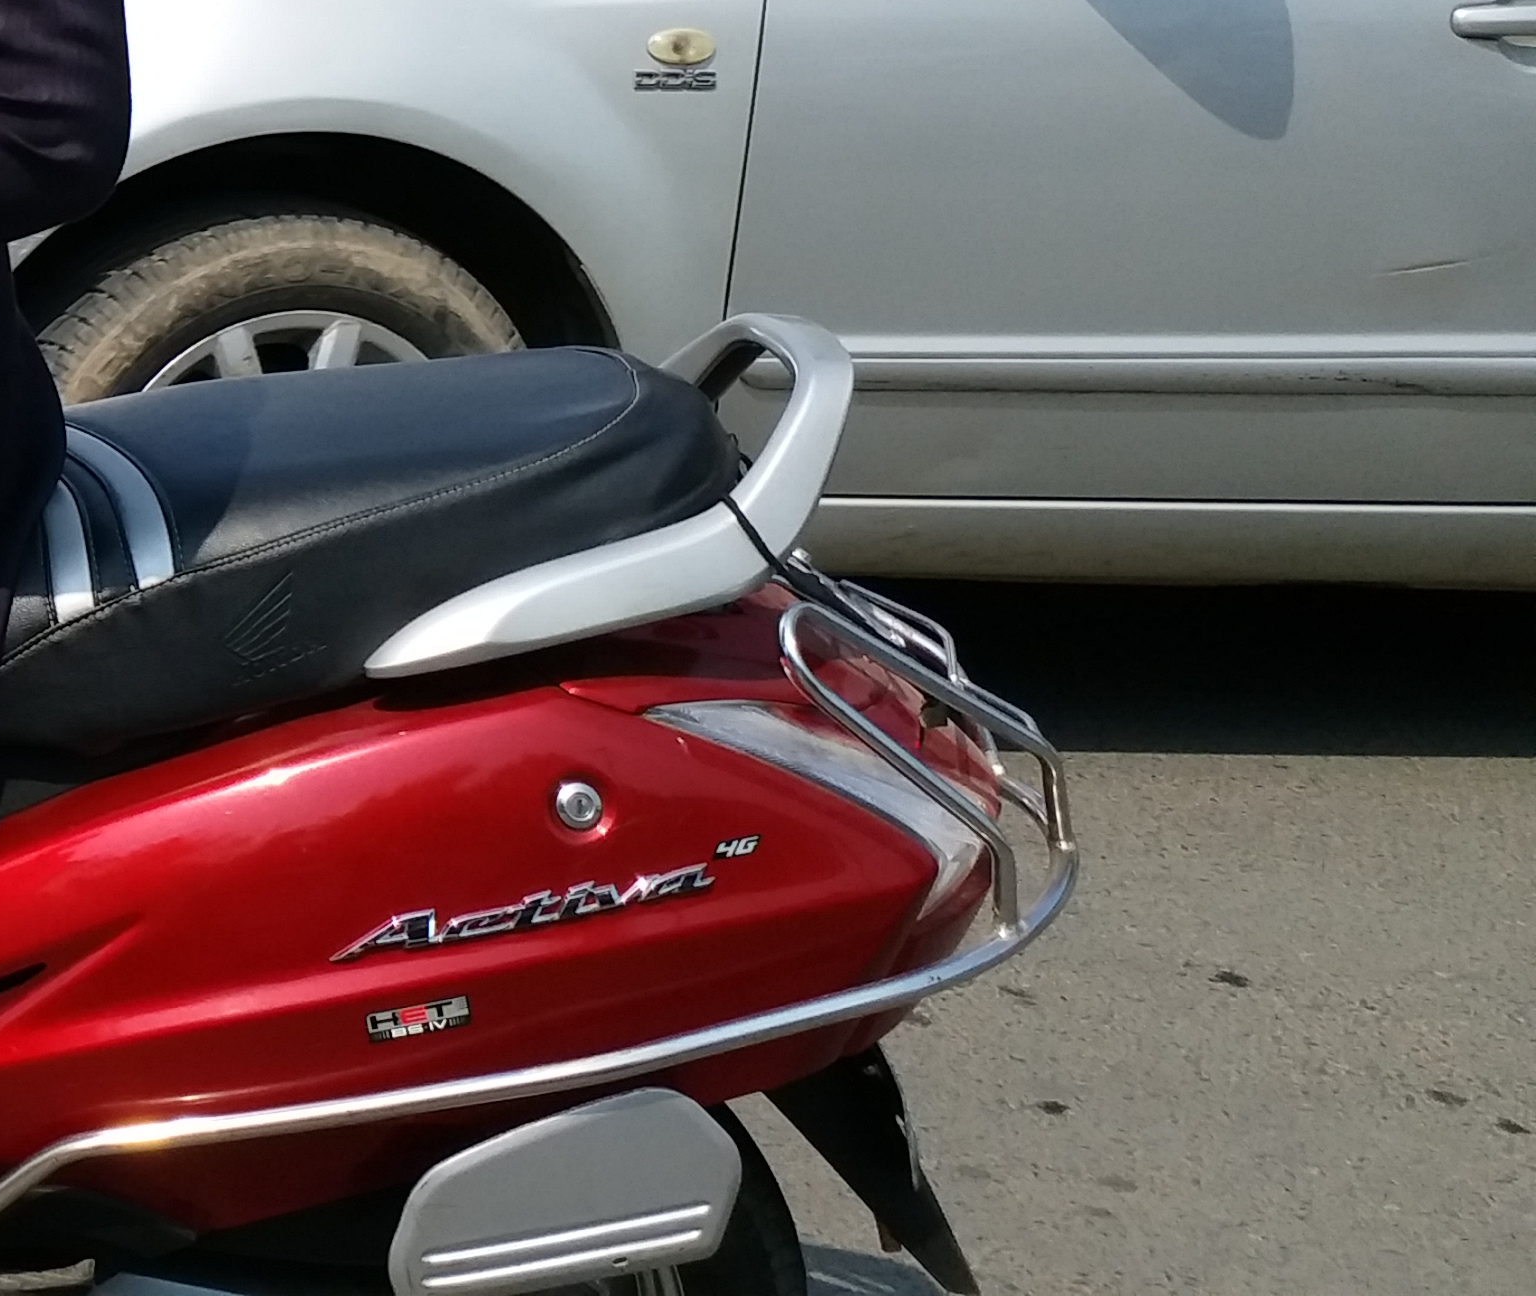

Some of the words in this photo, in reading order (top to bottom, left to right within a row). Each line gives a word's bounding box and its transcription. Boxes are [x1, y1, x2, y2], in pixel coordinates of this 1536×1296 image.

[716, 835, 759, 858] 4G
[329, 863, 716, 962] Activa
[370, 1001, 452, 1031] HET
